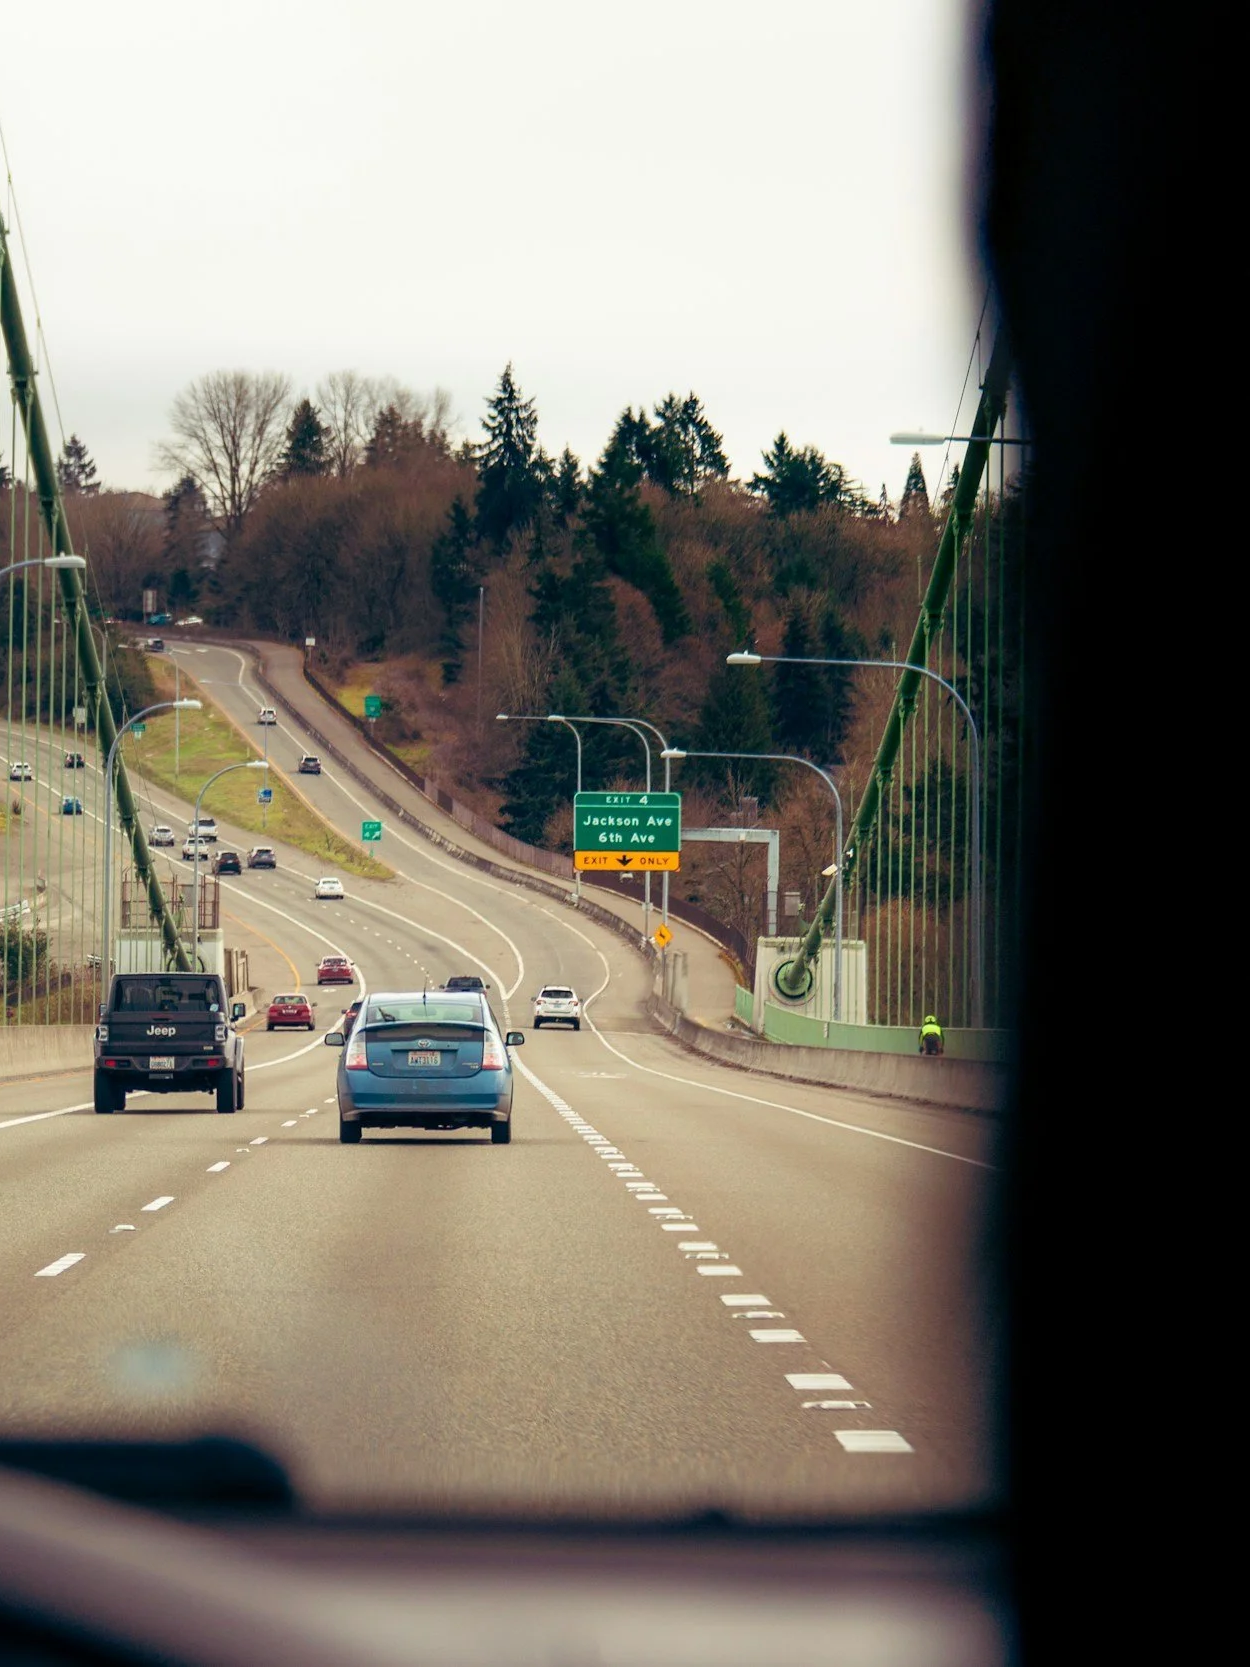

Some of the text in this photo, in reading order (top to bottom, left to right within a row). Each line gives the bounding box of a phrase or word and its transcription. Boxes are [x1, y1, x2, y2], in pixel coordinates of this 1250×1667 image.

[639, 795, 648, 805] 4
[583, 815, 672, 826] Jackson Ave
[598, 832, 655, 843] 6th Ave
[640, 857, 669, 865] ONLY
[146, 1025, 176, 1037] Jeep
